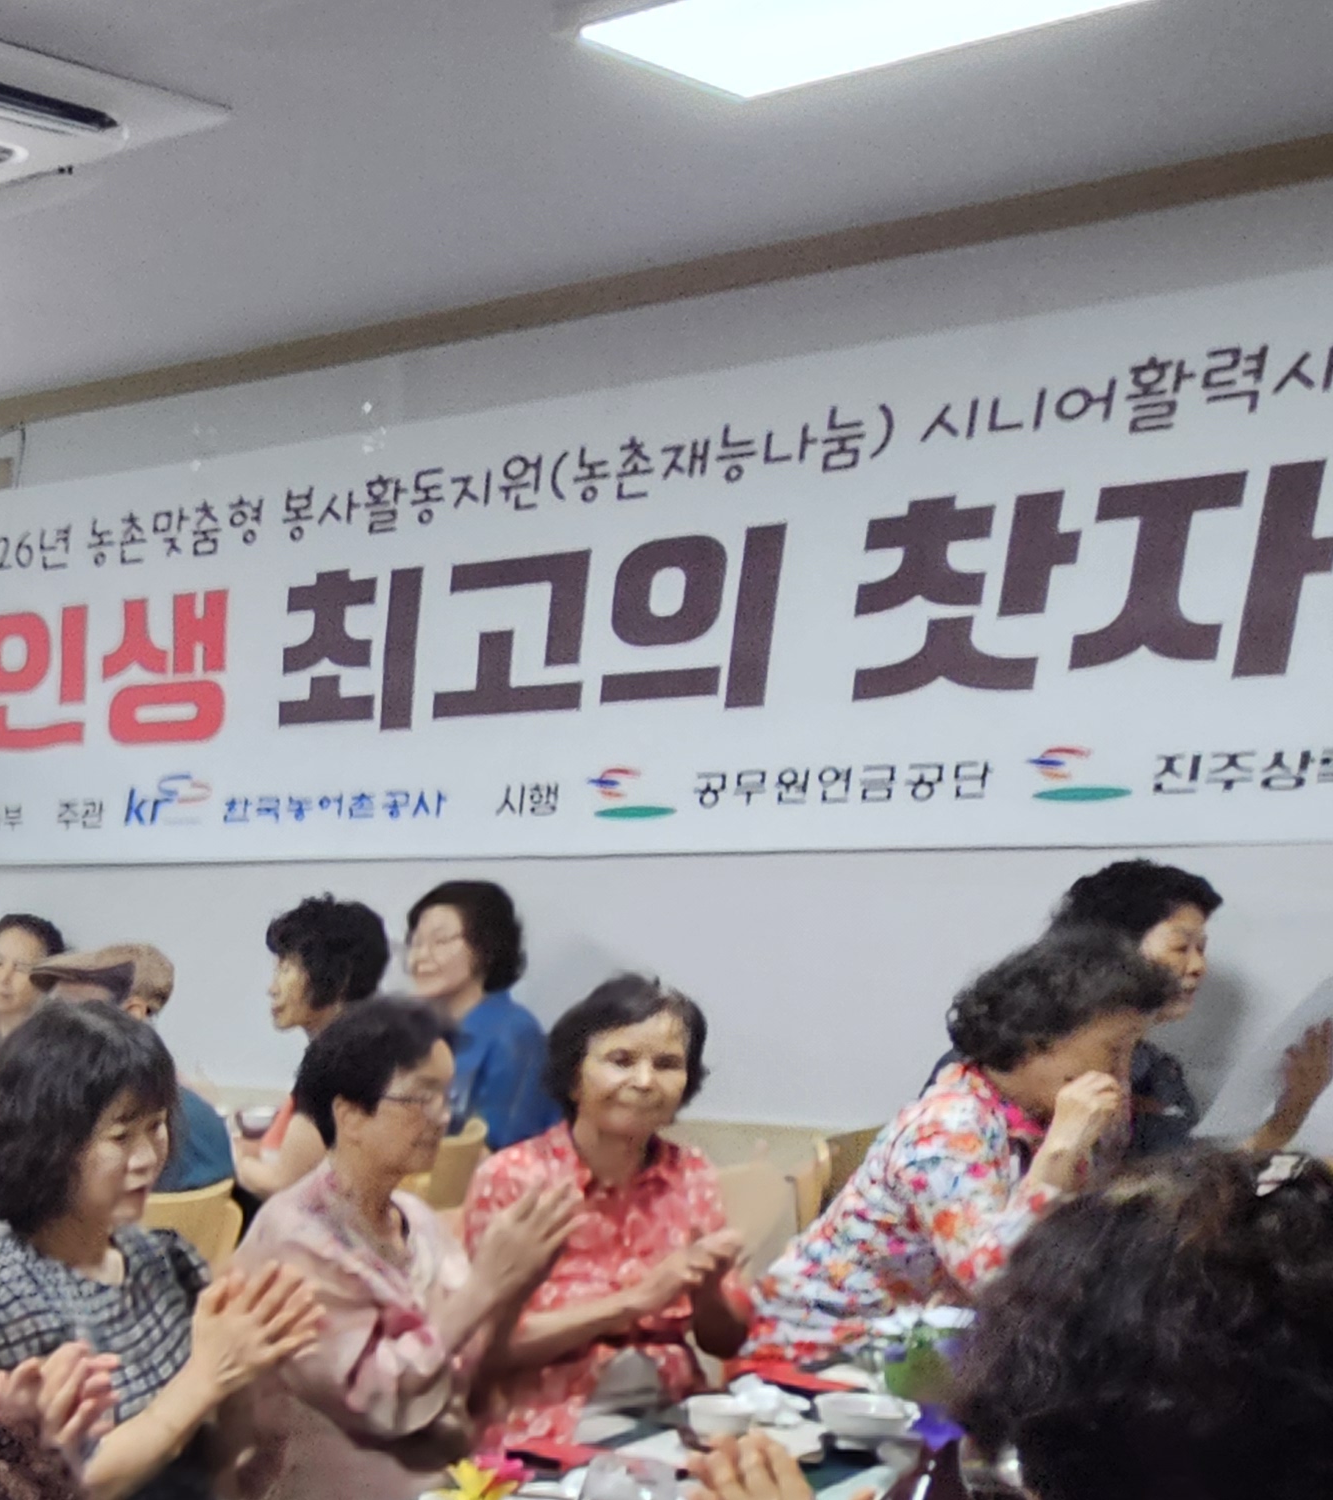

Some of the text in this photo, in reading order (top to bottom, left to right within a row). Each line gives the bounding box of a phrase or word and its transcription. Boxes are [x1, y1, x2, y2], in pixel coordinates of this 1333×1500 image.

[87, 497, 265, 567] 농촌맞춤형
[281, 403, 895, 542] 봉사활동지원(농촌재능나눔)
[278, 520, 788, 733] 최고의
[852, 457, 1333, 703] 찻자
[496, 782, 560, 818] 시행
[694, 759, 992, 809] 공무원연금공단
[56, 798, 104, 830] 주관
[222, 789, 447, 824] 한국농어촌공사
